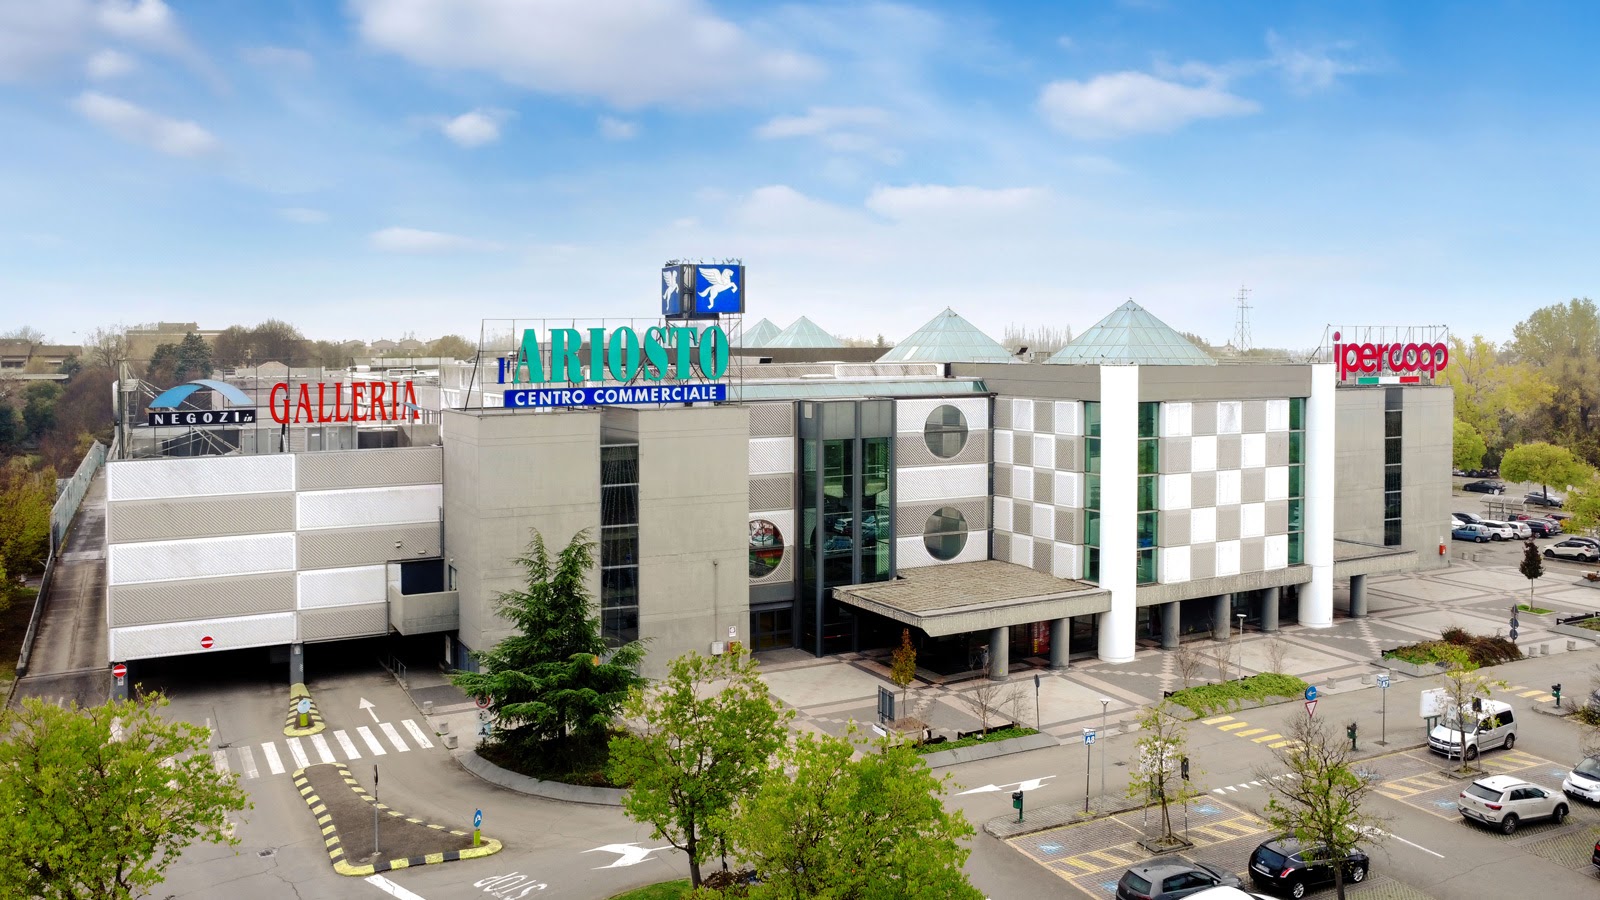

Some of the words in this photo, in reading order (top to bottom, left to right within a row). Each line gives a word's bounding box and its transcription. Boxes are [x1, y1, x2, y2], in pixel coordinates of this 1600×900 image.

[1333, 331, 1449, 381] ipercoop
[269, 380, 420, 424] GALLERIA
[514, 390, 585, 406] CENTRO
[593, 386, 717, 404] COMMERCIALE
[154, 410, 240, 425] NEGOZI
[473, 871, 548, 900] STOP
